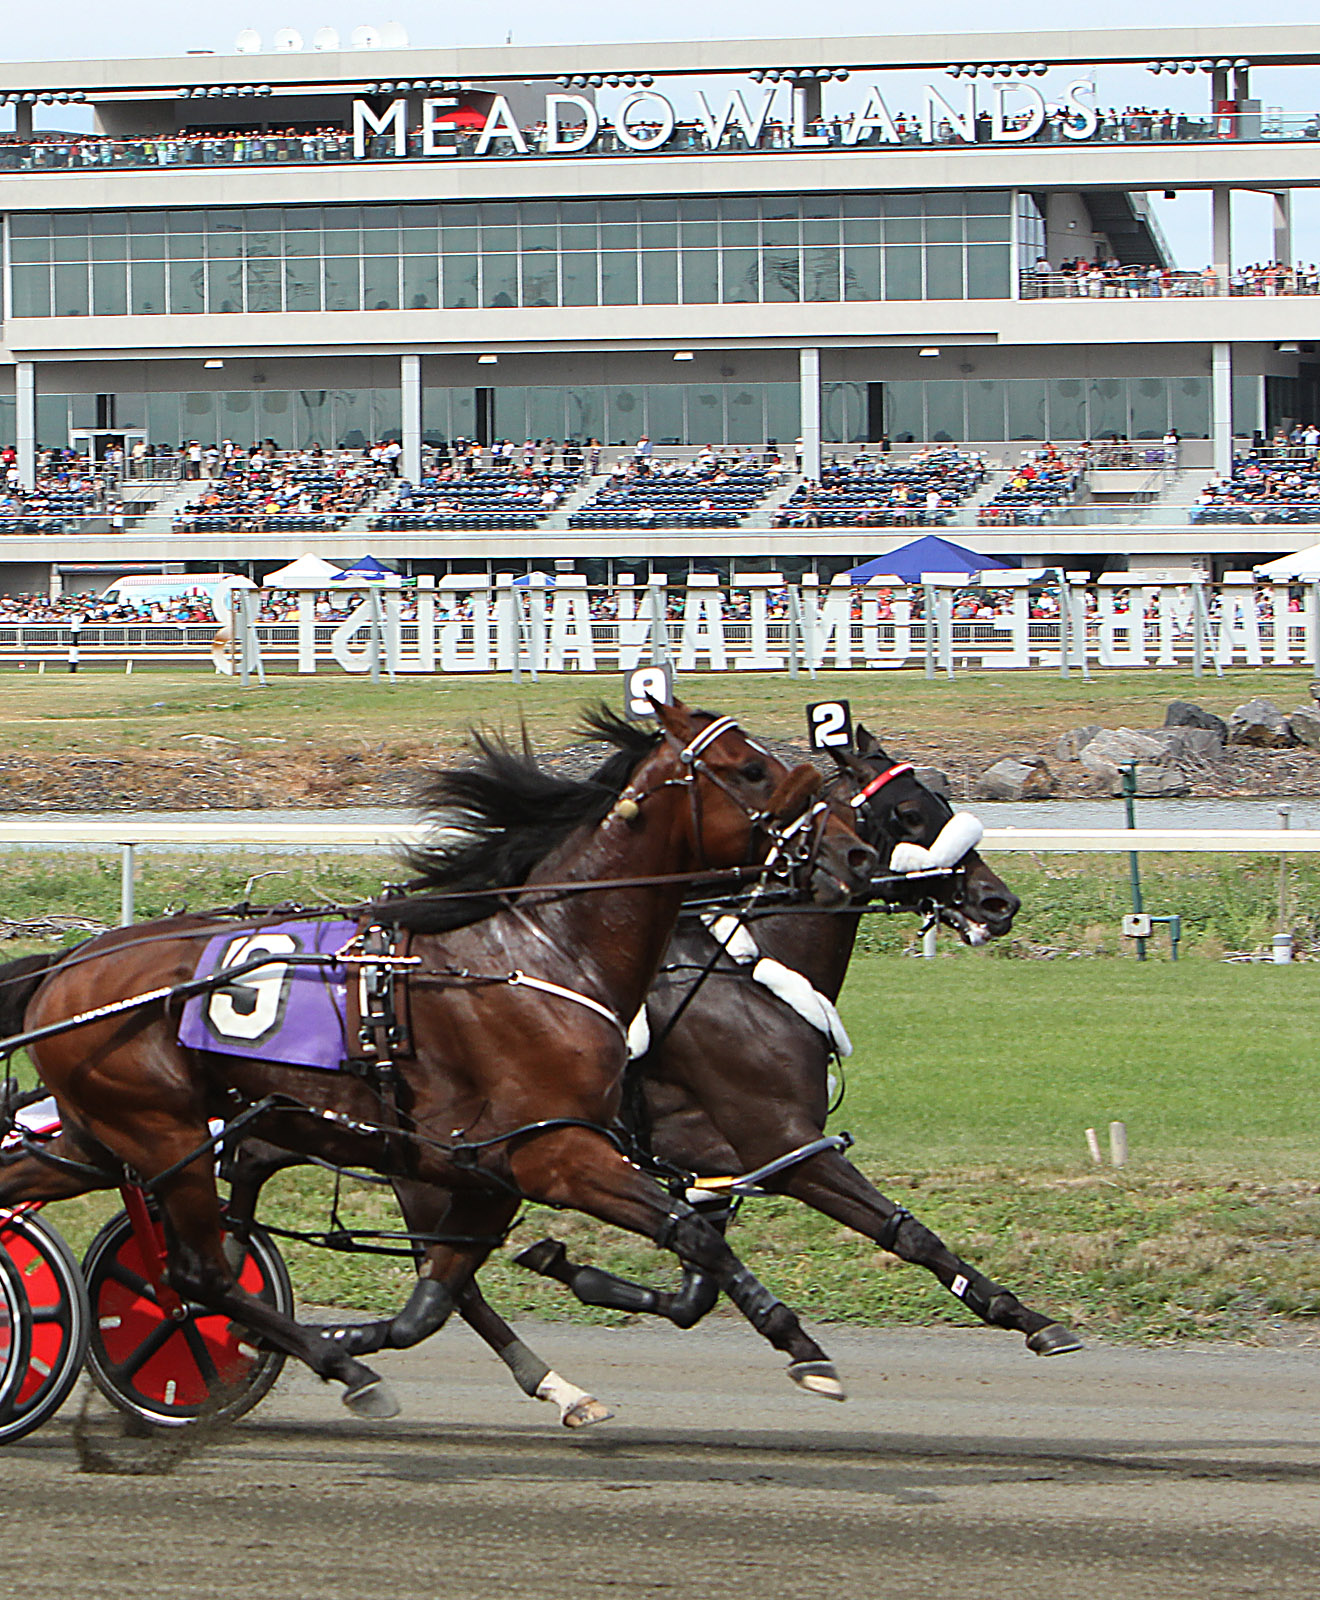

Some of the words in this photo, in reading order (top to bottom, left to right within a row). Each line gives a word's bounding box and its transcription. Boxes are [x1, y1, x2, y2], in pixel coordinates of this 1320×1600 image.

[352, 79, 1099, 158] MEADOWLANDS
[629, 667, 667, 716] 9
[812, 702, 849, 748] 2
[207, 933, 298, 1042] 9
